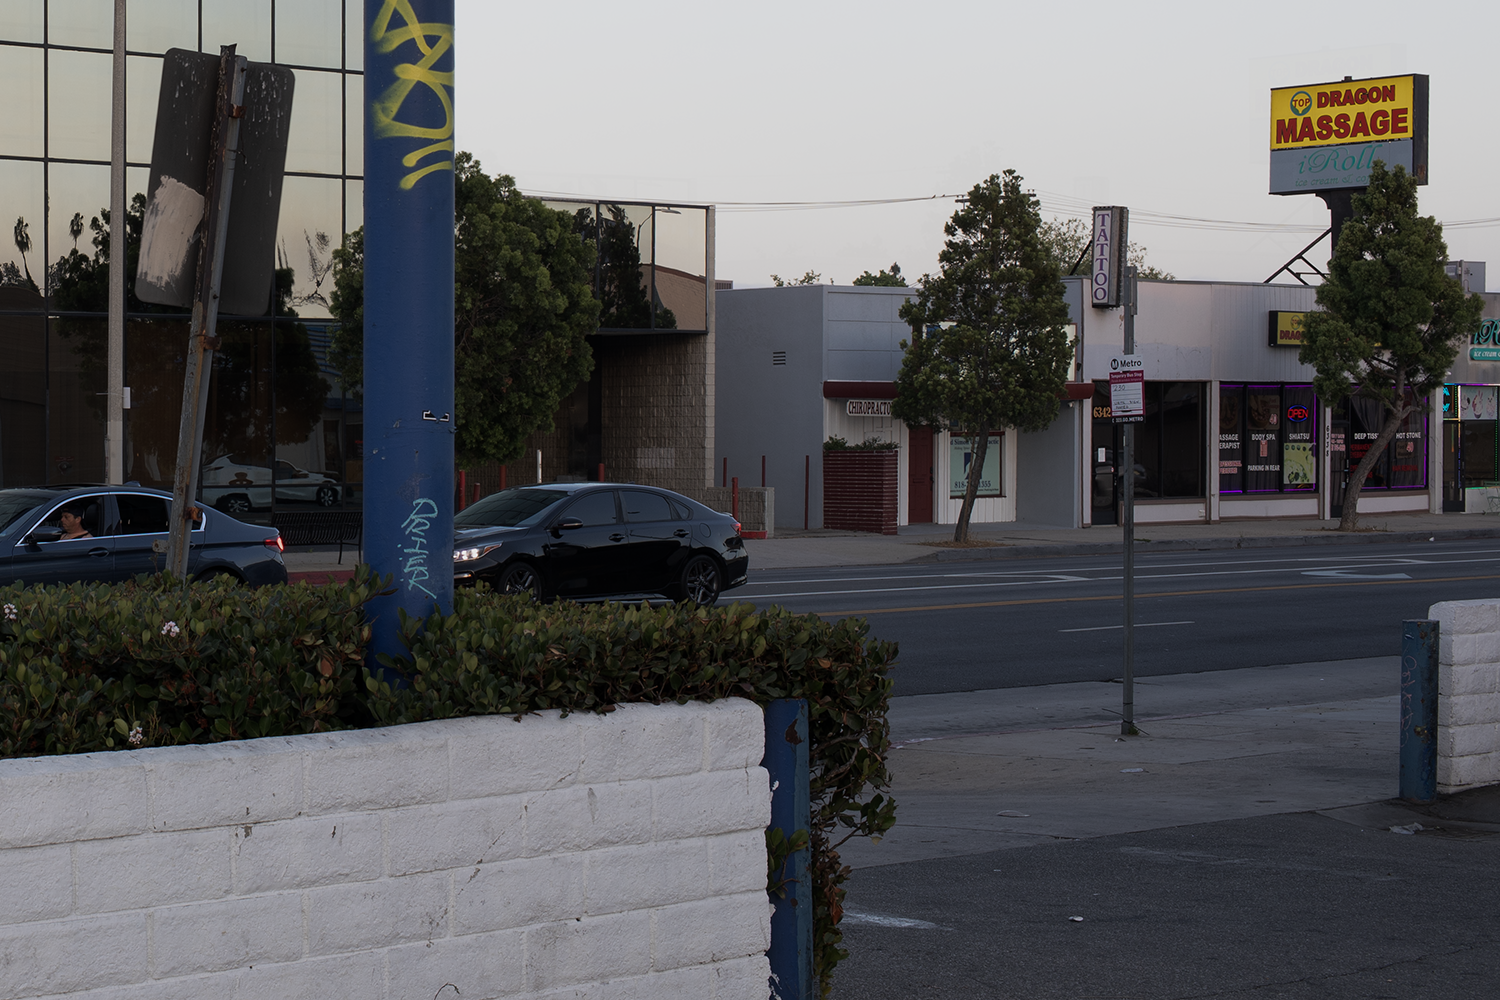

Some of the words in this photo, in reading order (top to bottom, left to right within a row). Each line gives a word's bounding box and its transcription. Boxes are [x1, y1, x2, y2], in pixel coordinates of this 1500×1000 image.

[1293, 98, 1310, 108] TOP
[1317, 84, 1396, 109] DRAGON
[1276, 108, 1408, 144] MASSAGE
[1299, 144, 1383, 174] iRoll
[1295, 178, 1308, 187] ice
[1311, 177, 1339, 186] cream
[1093, 213, 1110, 301] TATTOO
[1120, 360, 1142, 368] Metro
[848, 401, 893, 415] CHIROPRACTO
[1093, 406, 1111, 418] 6342
[1287, 408, 1309, 419] OPEN
[1219, 433, 1239, 441] ASSAGE
[1251, 433, 1265, 441] BODY
[1265, 433, 1276, 441] SPA
[1289, 433, 1310, 441] SHIATSU
[1367, 432, 1379, 440] TISS
